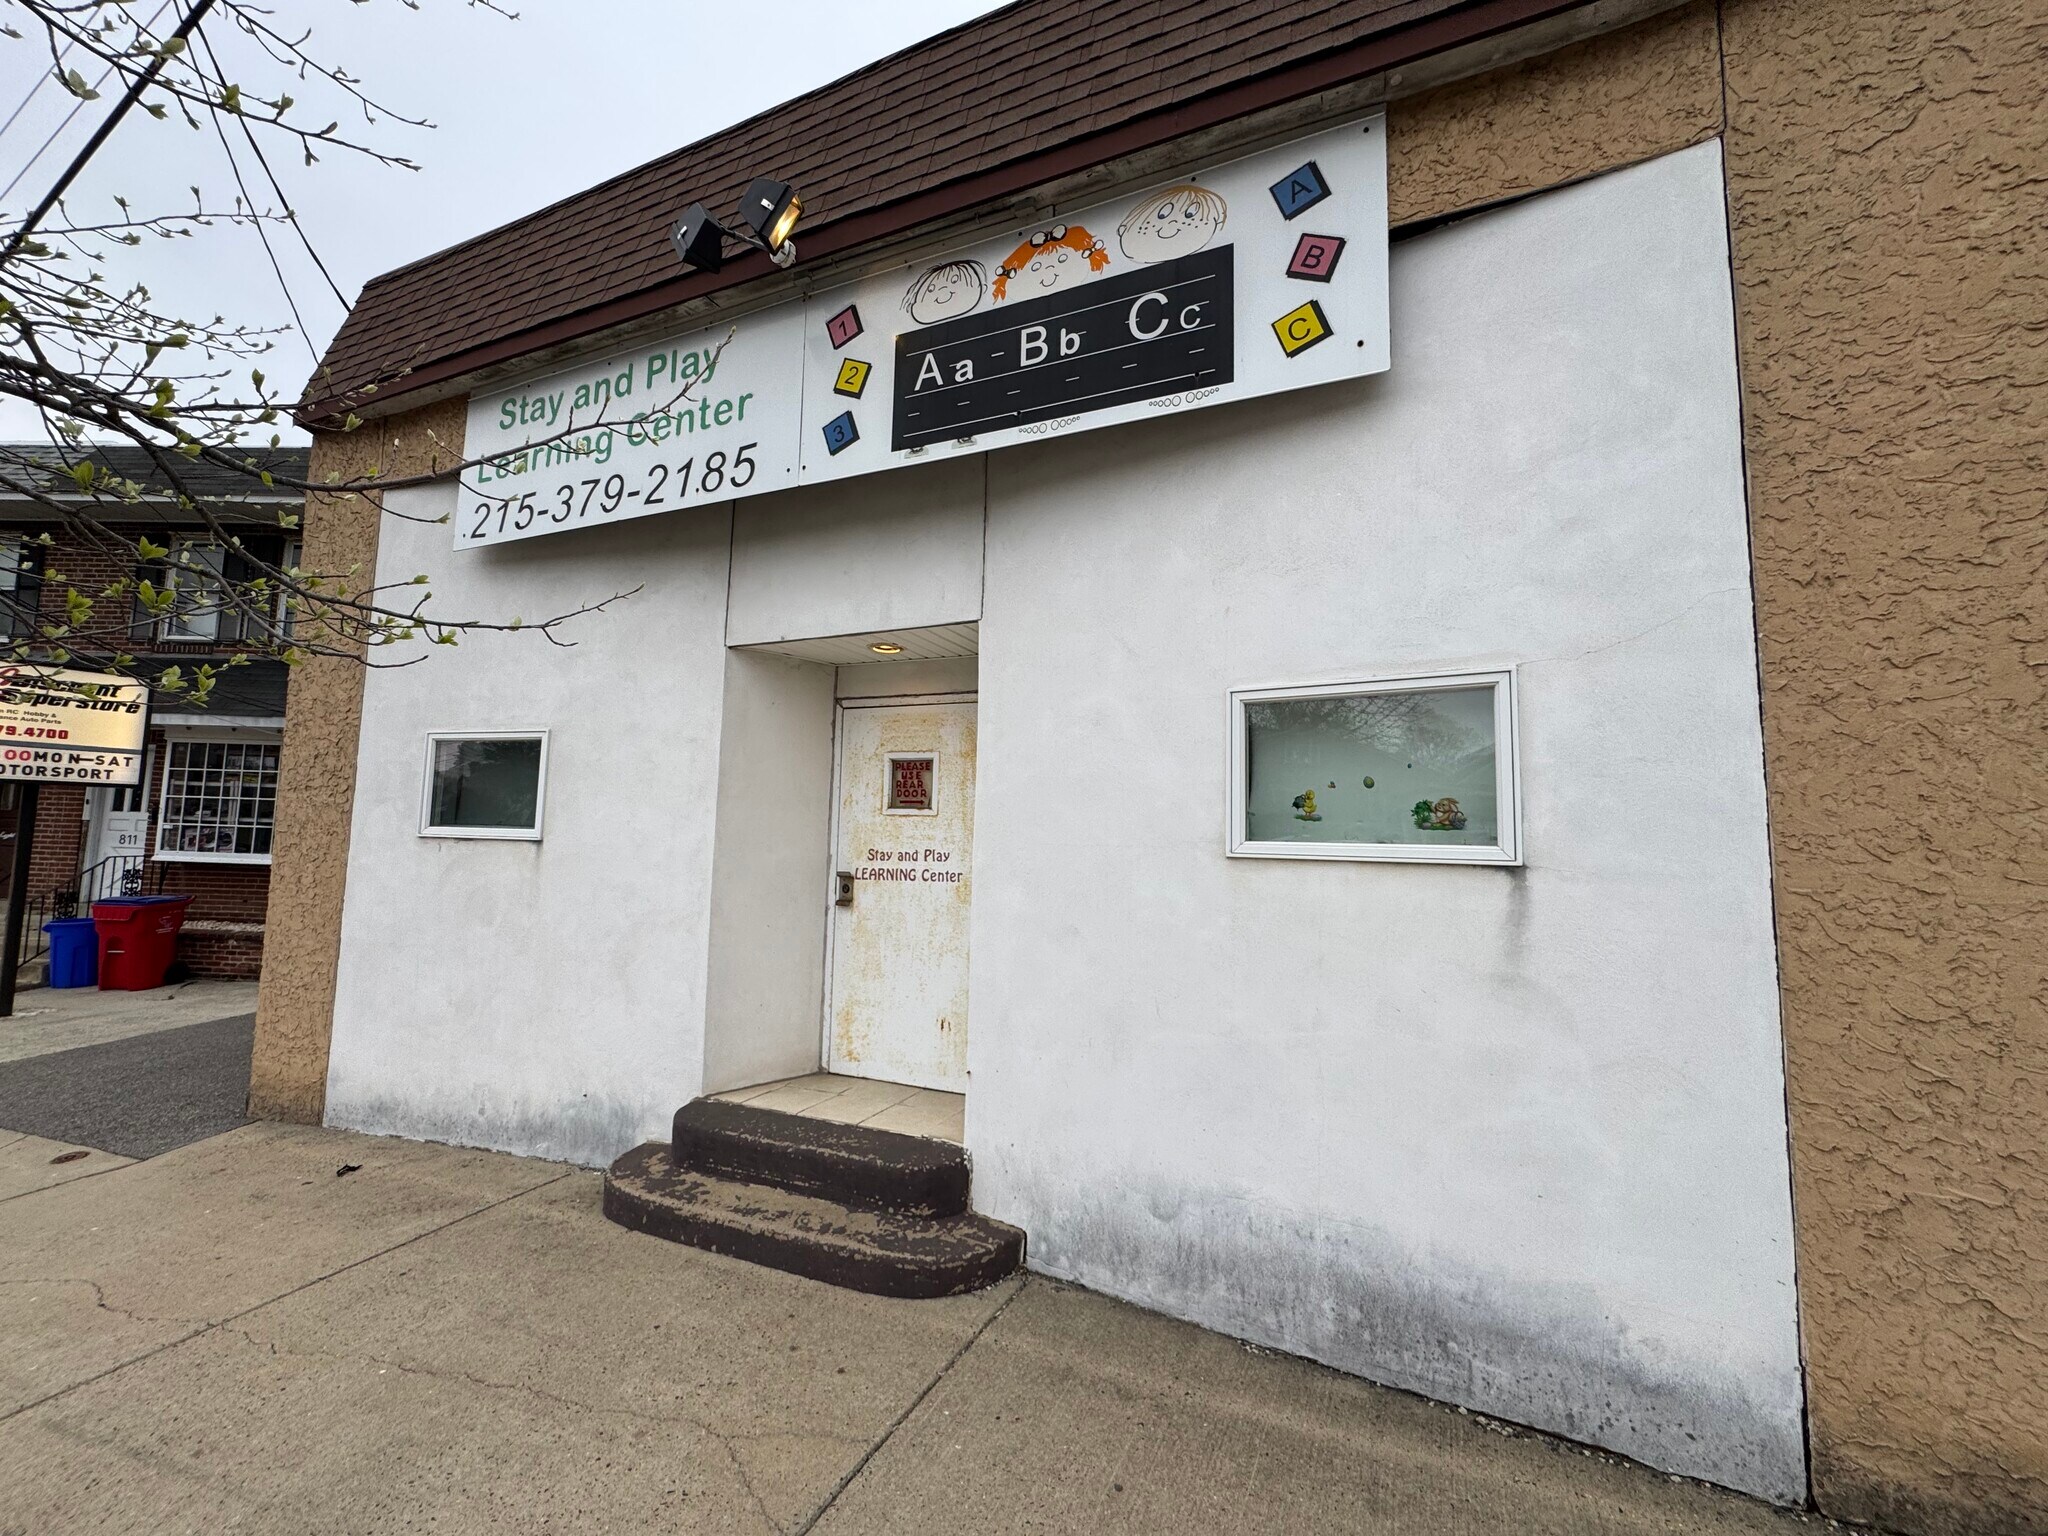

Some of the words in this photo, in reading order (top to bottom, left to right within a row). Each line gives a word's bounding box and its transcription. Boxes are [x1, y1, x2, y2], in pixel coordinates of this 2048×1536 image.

[1291, 179, 1313, 205] A
[1300, 244, 1326, 270] B
[838, 320, 848, 337] 1
[1287, 317, 1311, 341] C
[844, 366, 859, 386] 2
[499, 391, 564, 431] Stay
[573, 362, 634, 410] and
[646, 348, 718, 390] Play
[627, 392, 754, 447] Center
[832, 424, 845, 443] 3
[470, 442, 758, 540] 215-379-2185
[23, 710, 49, 718] Hobby
[895, 761, 931, 771] PLEASE
[901, 771, 921, 780] USE
[896, 780, 924, 789] REAR
[896, 789, 927, 798] DOOR
[118, 834, 138, 845] 811
[867, 848, 893, 861] Stay
[897, 849, 918, 861] and
[924, 849, 950, 862] Play
[855, 867, 917, 881] LEARNING
[921, 869, 963, 882] Center
